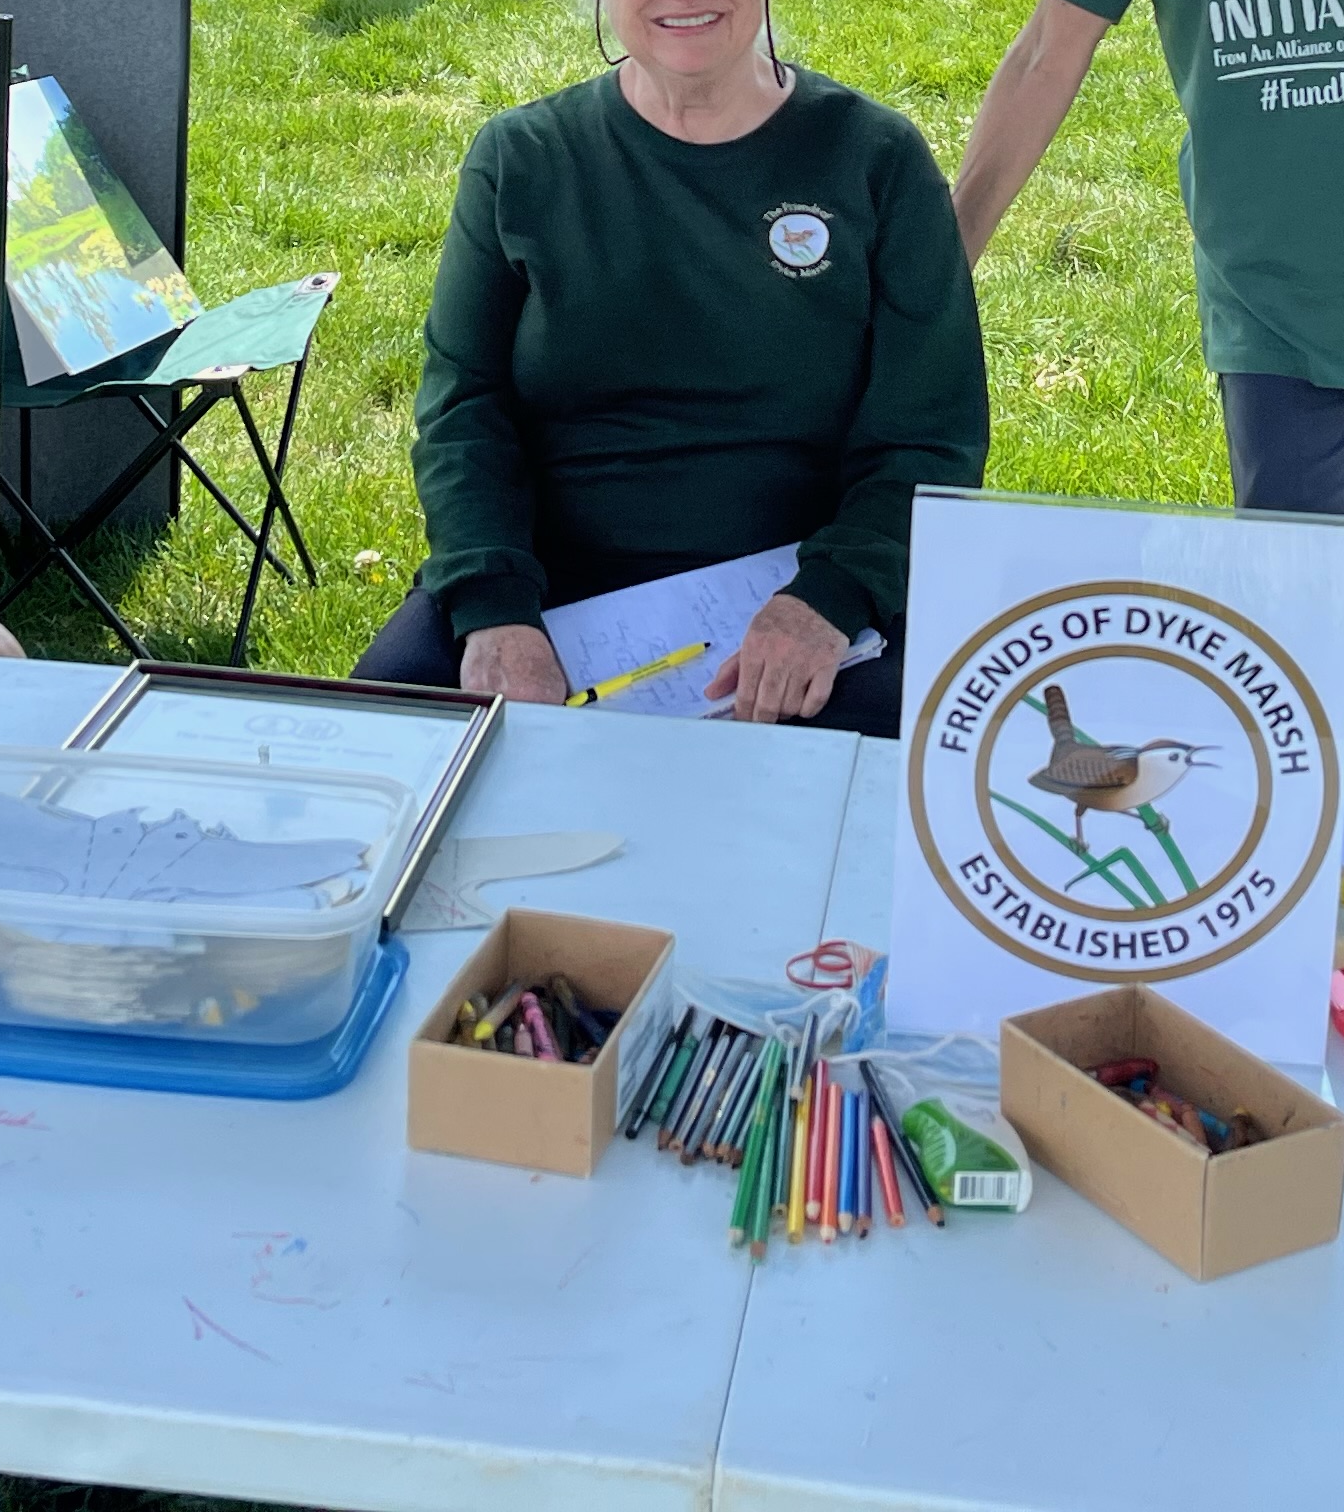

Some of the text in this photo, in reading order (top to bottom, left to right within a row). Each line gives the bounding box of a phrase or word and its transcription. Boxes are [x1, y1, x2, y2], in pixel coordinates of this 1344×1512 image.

[1250, 43, 1273, 62] An
[1276, 39, 1333, 59] Alliance
[940, 607, 1310, 776] FRIENDS OF DYKE MARSH
[959, 852, 1278, 960] ESTABLISHED 1975
